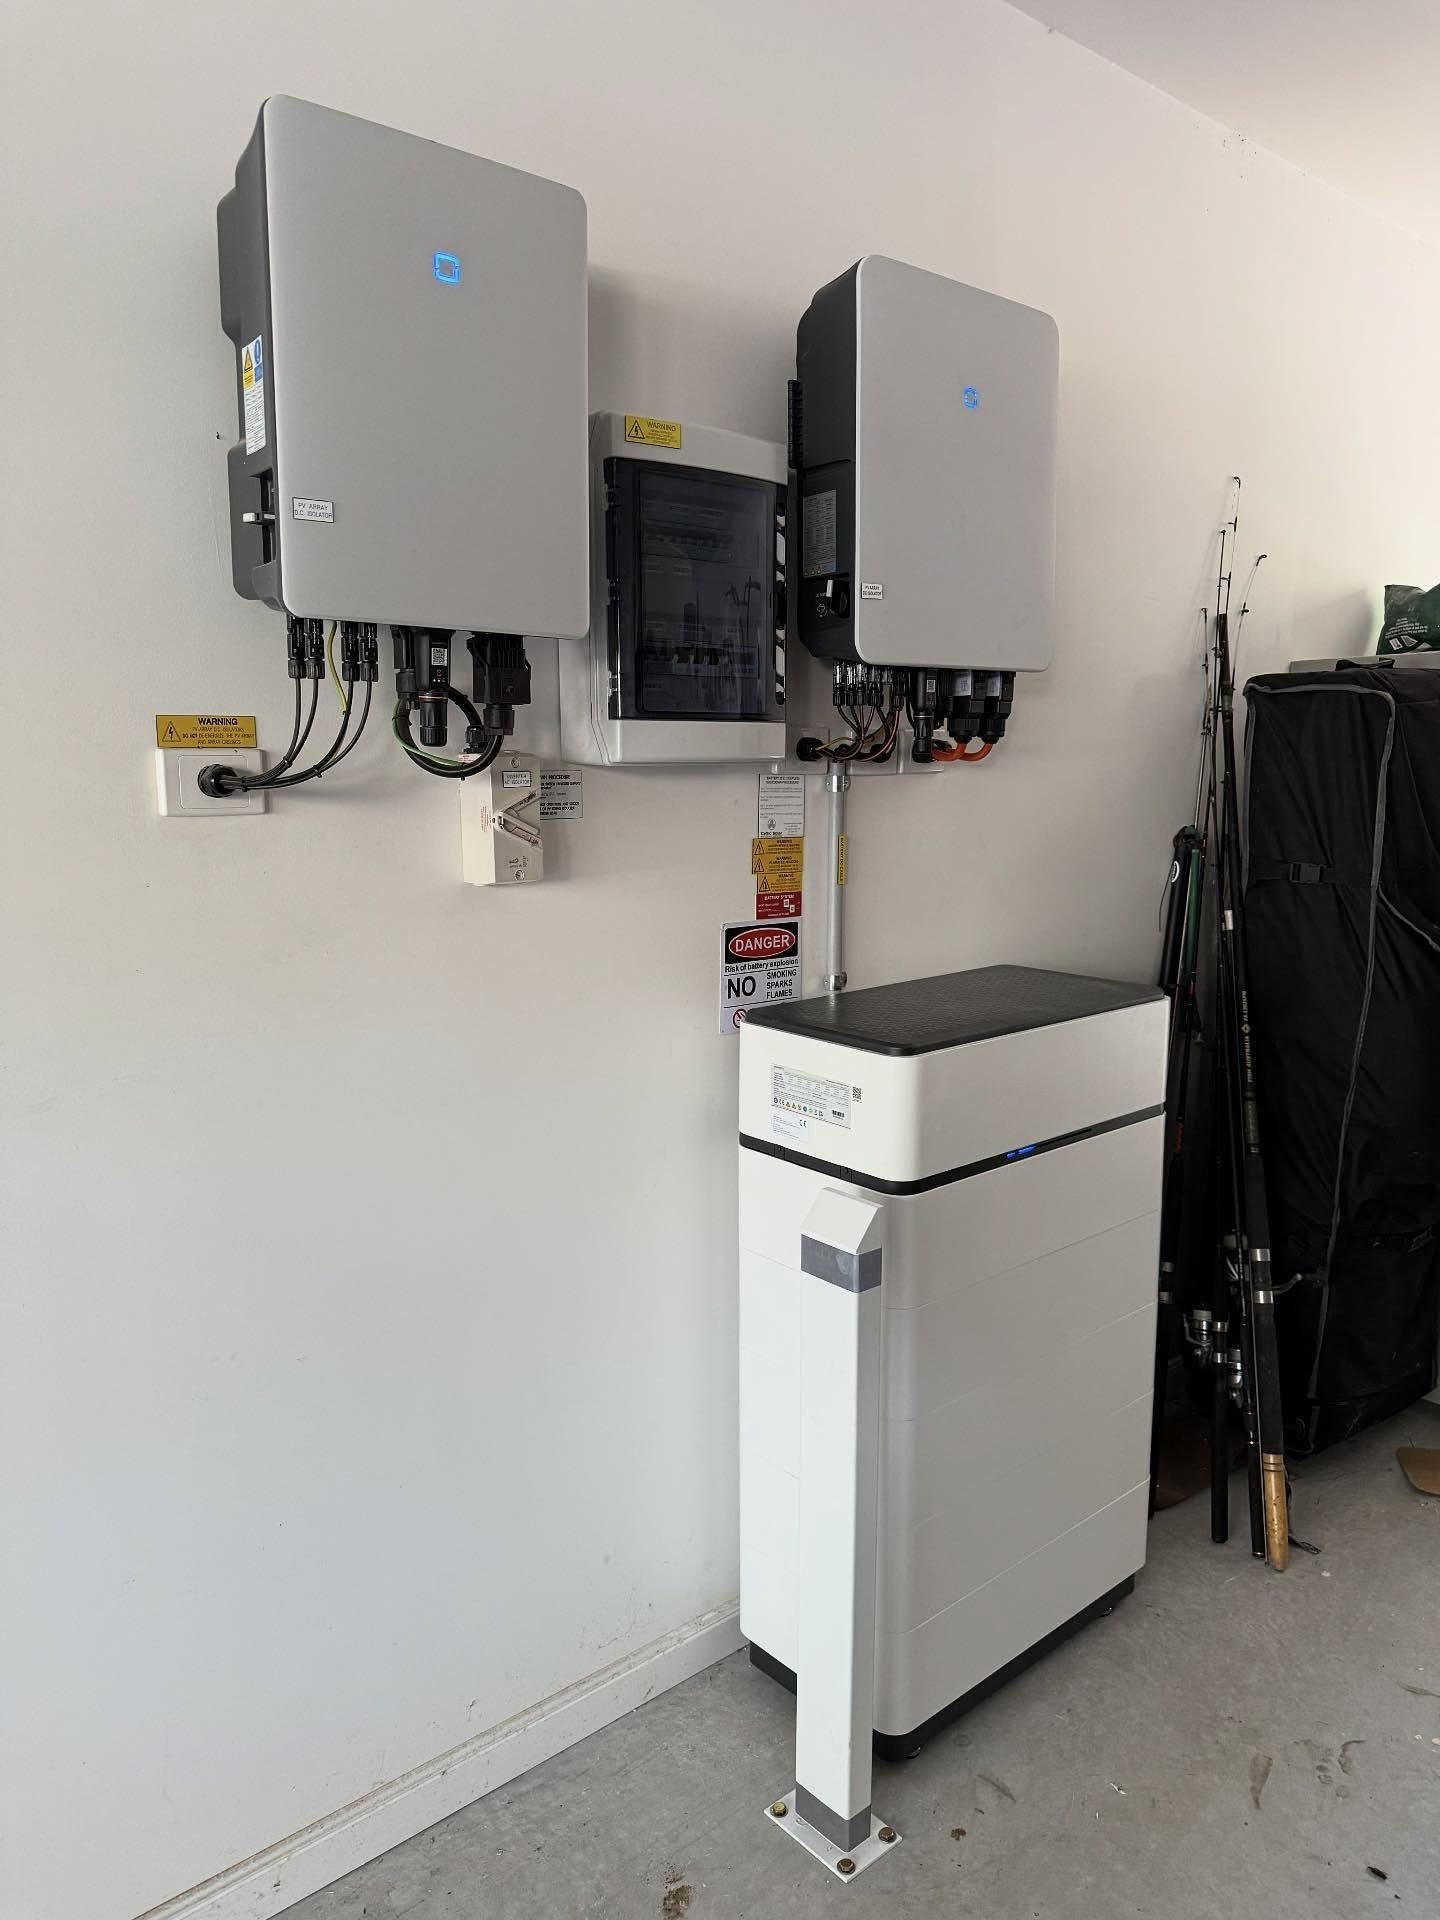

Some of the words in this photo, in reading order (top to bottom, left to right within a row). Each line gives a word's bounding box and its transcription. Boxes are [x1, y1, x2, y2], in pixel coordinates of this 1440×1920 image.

[647, 421, 676, 431] WARNING
[735, 934, 790, 952] DANGER
[725, 965, 739, 973] Risk
[747, 961, 769, 971] battery
[770, 959, 799, 969] explosion
[767, 969, 797, 979] SMOKING
[727, 976, 756, 999] NO
[767, 980, 792, 989] SPARKS
[767, 989, 792, 999] FLAMES
